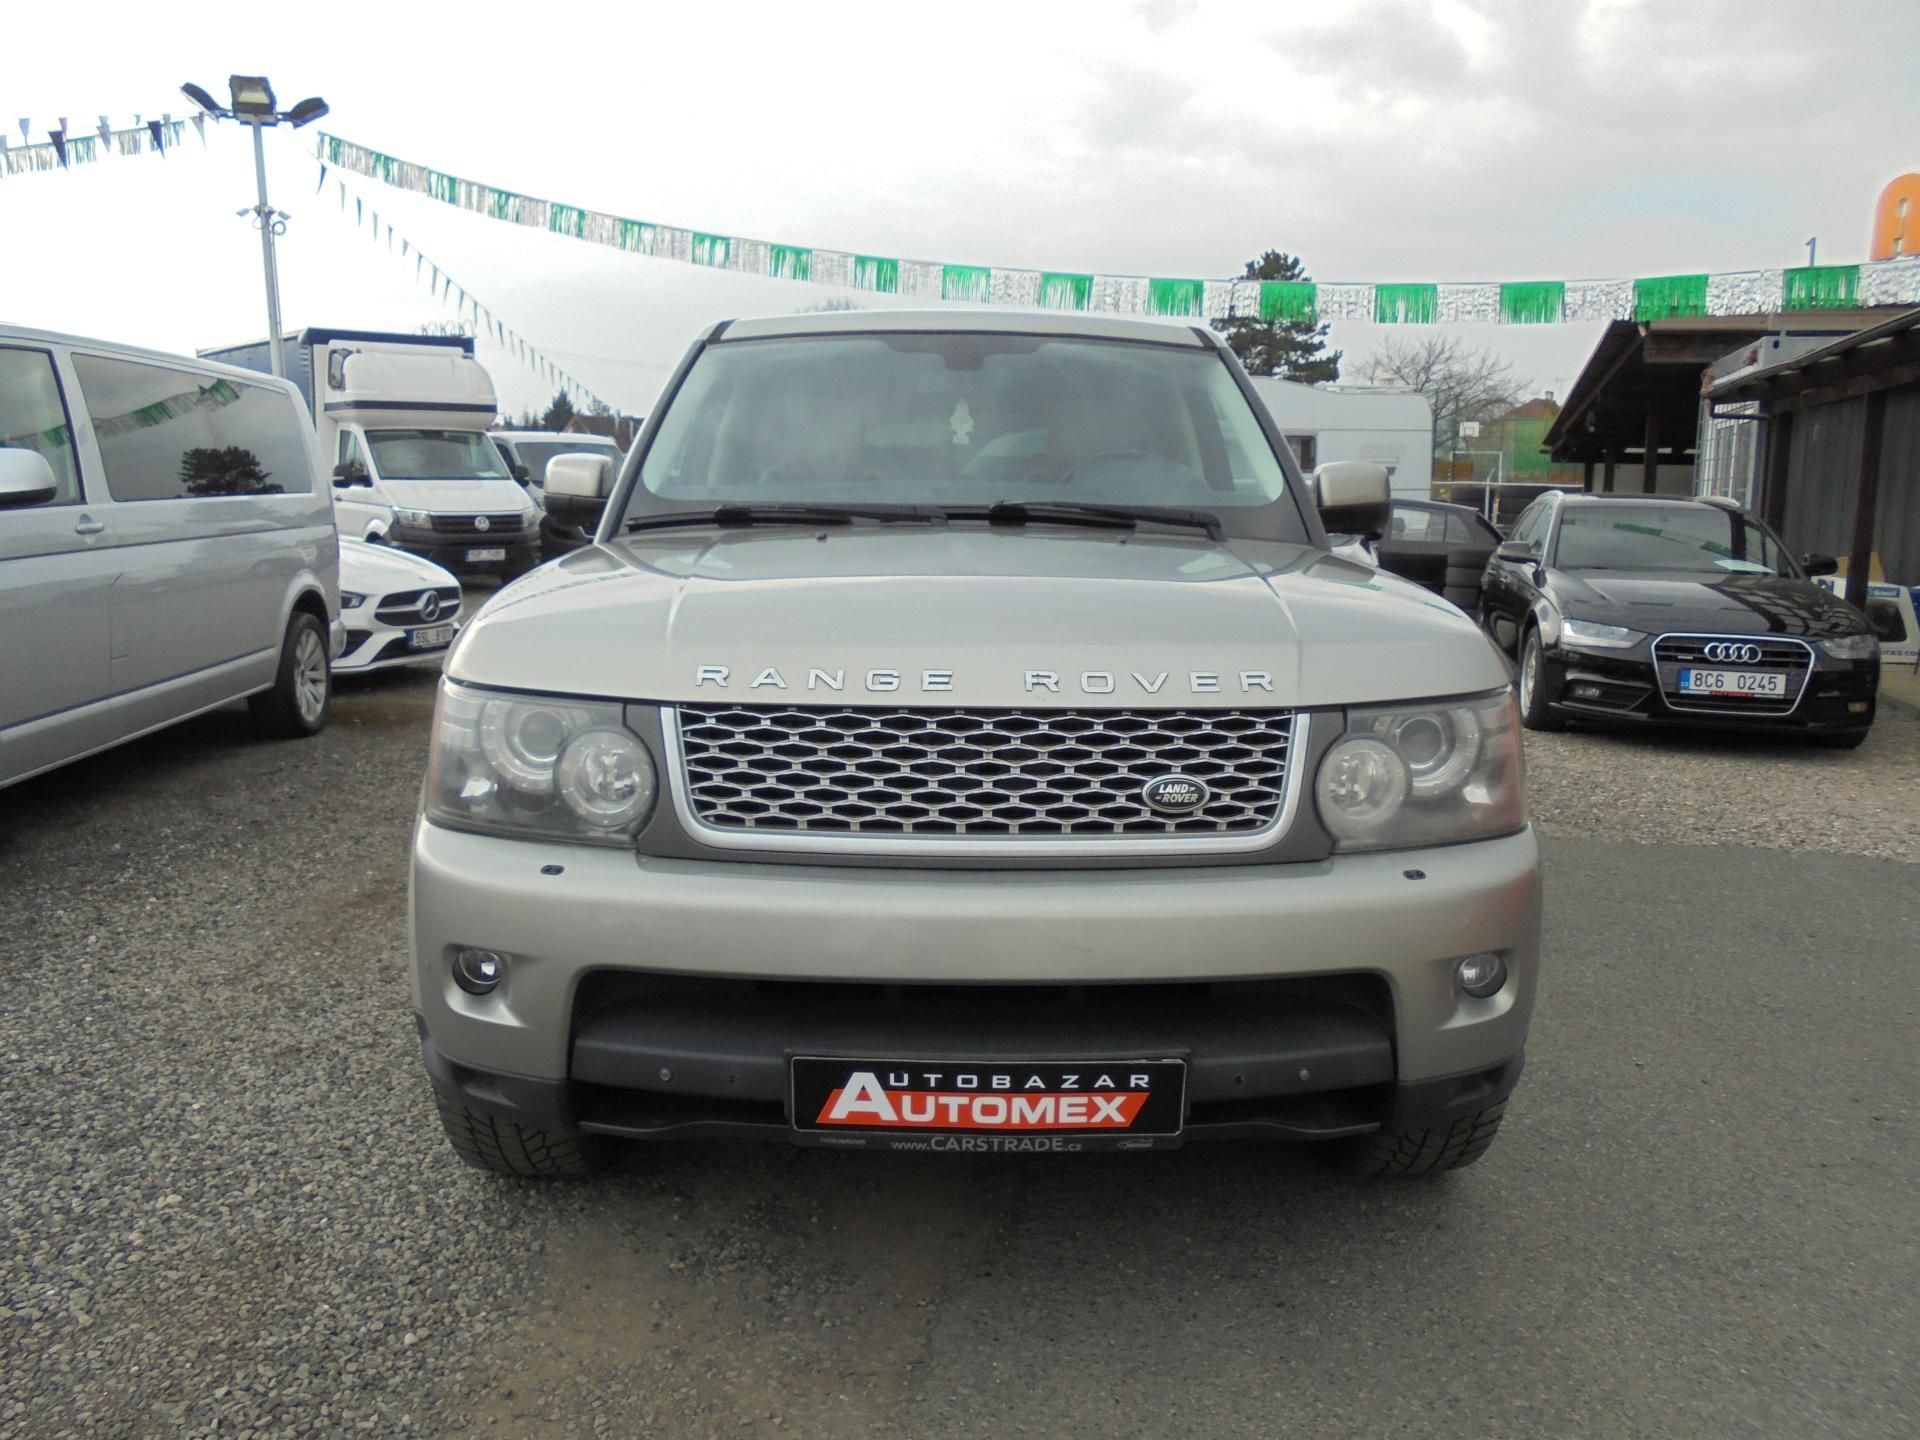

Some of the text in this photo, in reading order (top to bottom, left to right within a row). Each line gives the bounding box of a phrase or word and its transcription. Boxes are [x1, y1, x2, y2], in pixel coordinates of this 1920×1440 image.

[695, 665, 1275, 694] RANGE ROVER
[1694, 672, 1778, 692] 8C6 0245
[1158, 783, 1189, 794] LAND
[1161, 793, 1199, 803] ROVER
[828, 1071, 1127, 1125] AUTOMEX
